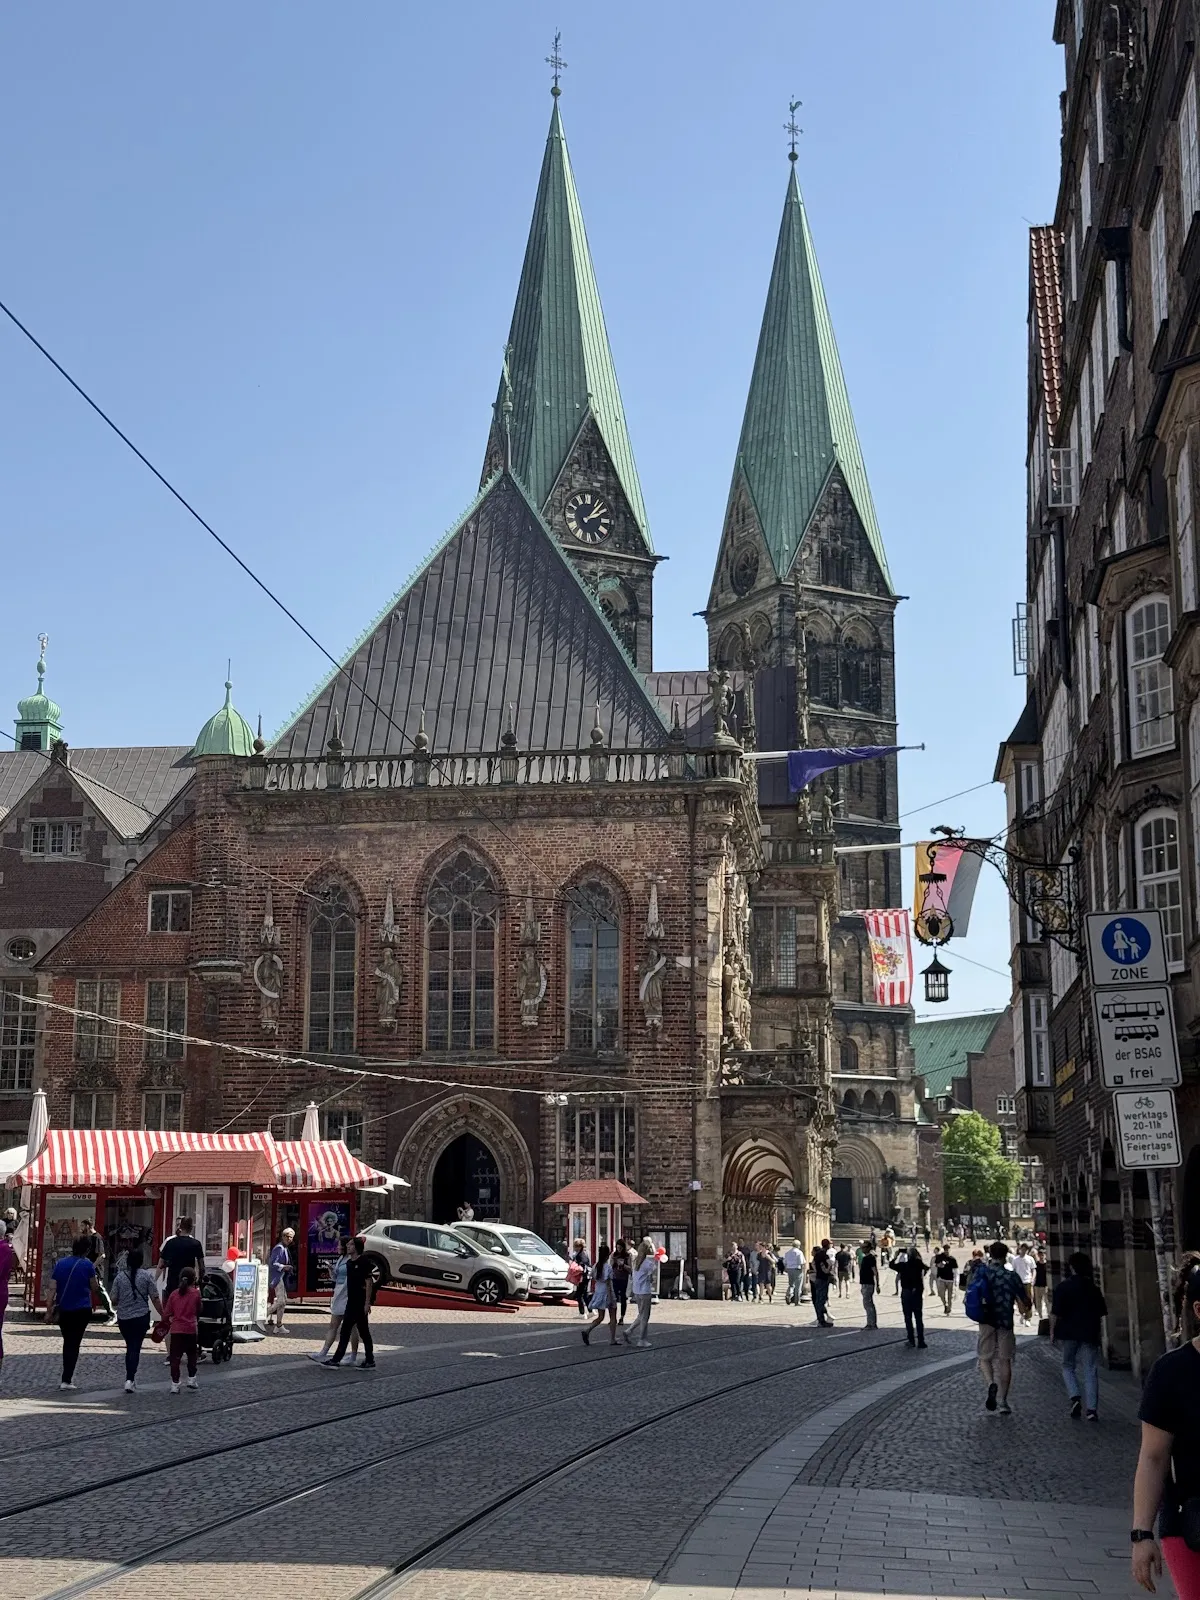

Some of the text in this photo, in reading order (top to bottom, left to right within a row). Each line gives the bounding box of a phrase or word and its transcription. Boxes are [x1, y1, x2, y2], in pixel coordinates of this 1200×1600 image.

[1111, 967, 1149, 980] ZONE
[1115, 1047, 1162, 1060] der BSAG
[1130, 1066, 1154, 1079] frei
[1123, 1111, 1168, 1120] werktags
[1133, 1121, 1161, 1131] 20-11h
[1123, 1131, 1174, 1141] Sonn- und
[1127, 1142, 1172, 1152] Feiertags
[1143, 1152, 1160, 1161] frei
